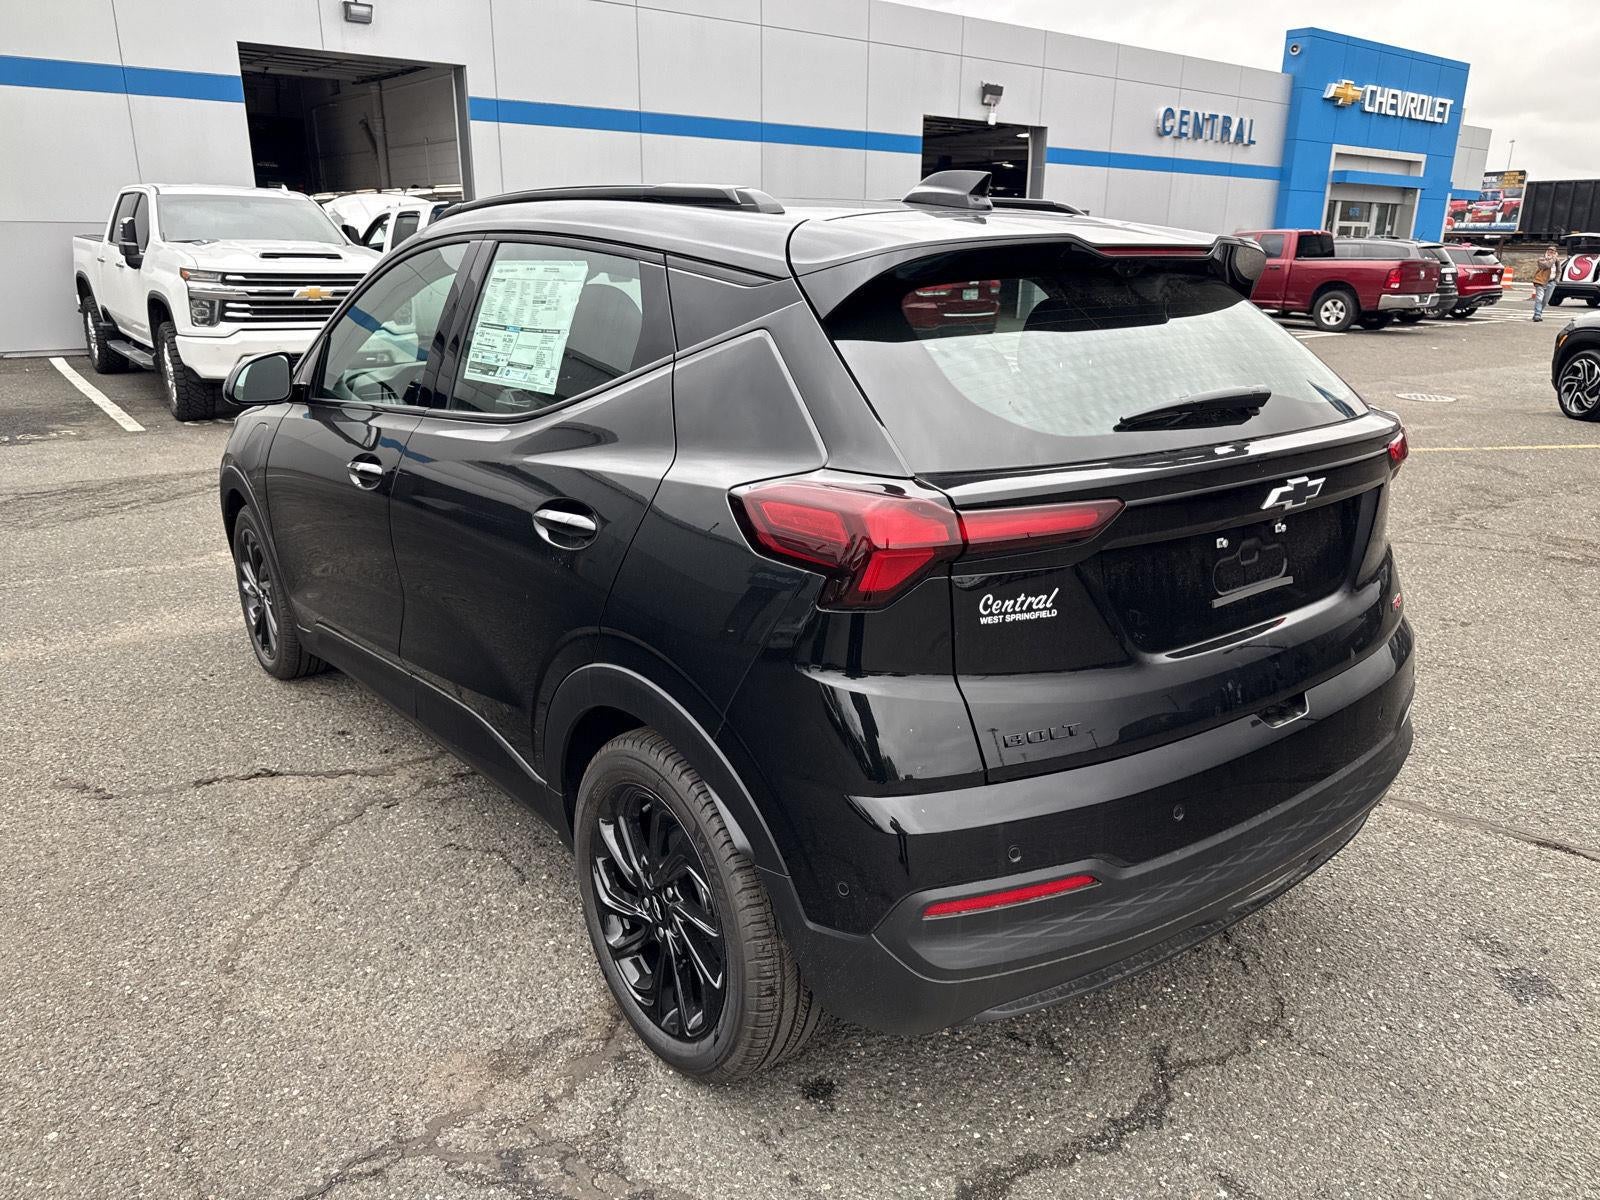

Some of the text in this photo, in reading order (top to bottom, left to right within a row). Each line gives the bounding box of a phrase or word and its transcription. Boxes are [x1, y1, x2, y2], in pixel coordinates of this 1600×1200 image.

[1361, 84, 1454, 124] CHEVROLET
[1157, 107, 1257, 146] CENTRAL
[979, 587, 1060, 615] Central
[979, 609, 1058, 625] WEST SPRINGFIELD
[1002, 721, 1082, 749] BOLT
